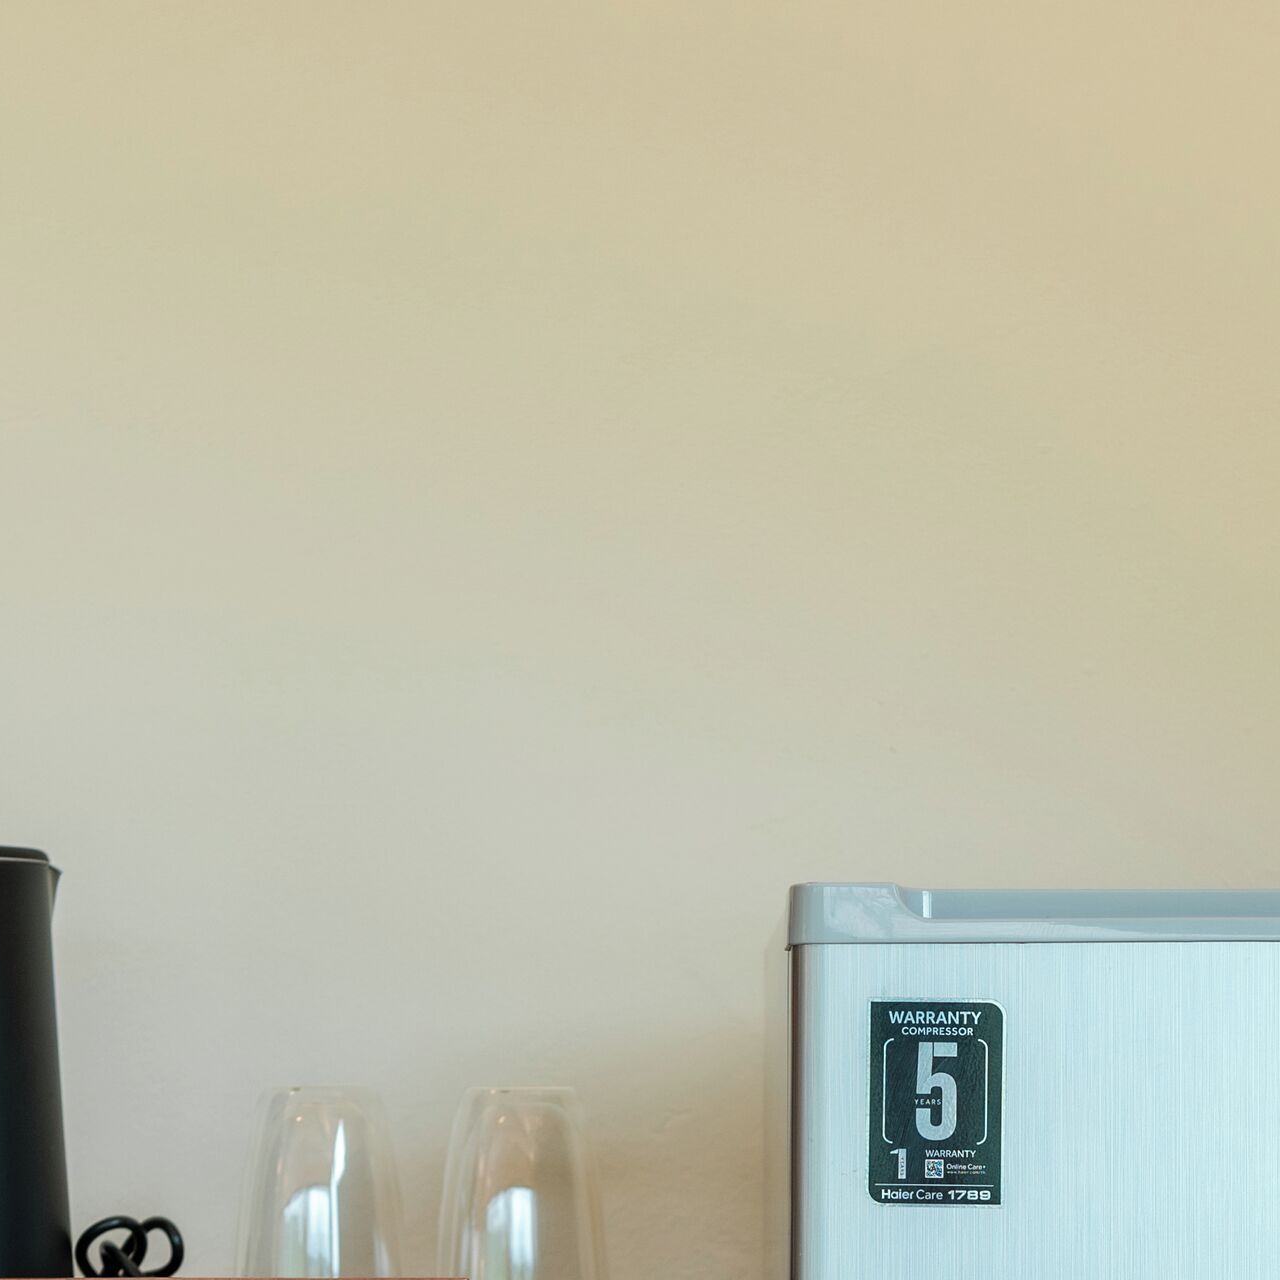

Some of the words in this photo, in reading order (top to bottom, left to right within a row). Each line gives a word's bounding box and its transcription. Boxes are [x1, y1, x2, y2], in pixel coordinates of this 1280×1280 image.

[889, 1011, 981, 1024] WARRANTY
[902, 1027, 973, 1035] COMPRESSOR
[915, 1042, 957, 1140] 5
[925, 1150, 976, 1158] WARRANTY
[890, 1148, 906, 1179] 1
[881, 1189, 913, 1200] Haier
[916, 1189, 943, 1200] Care
[948, 1189, 991, 1200] 1789
